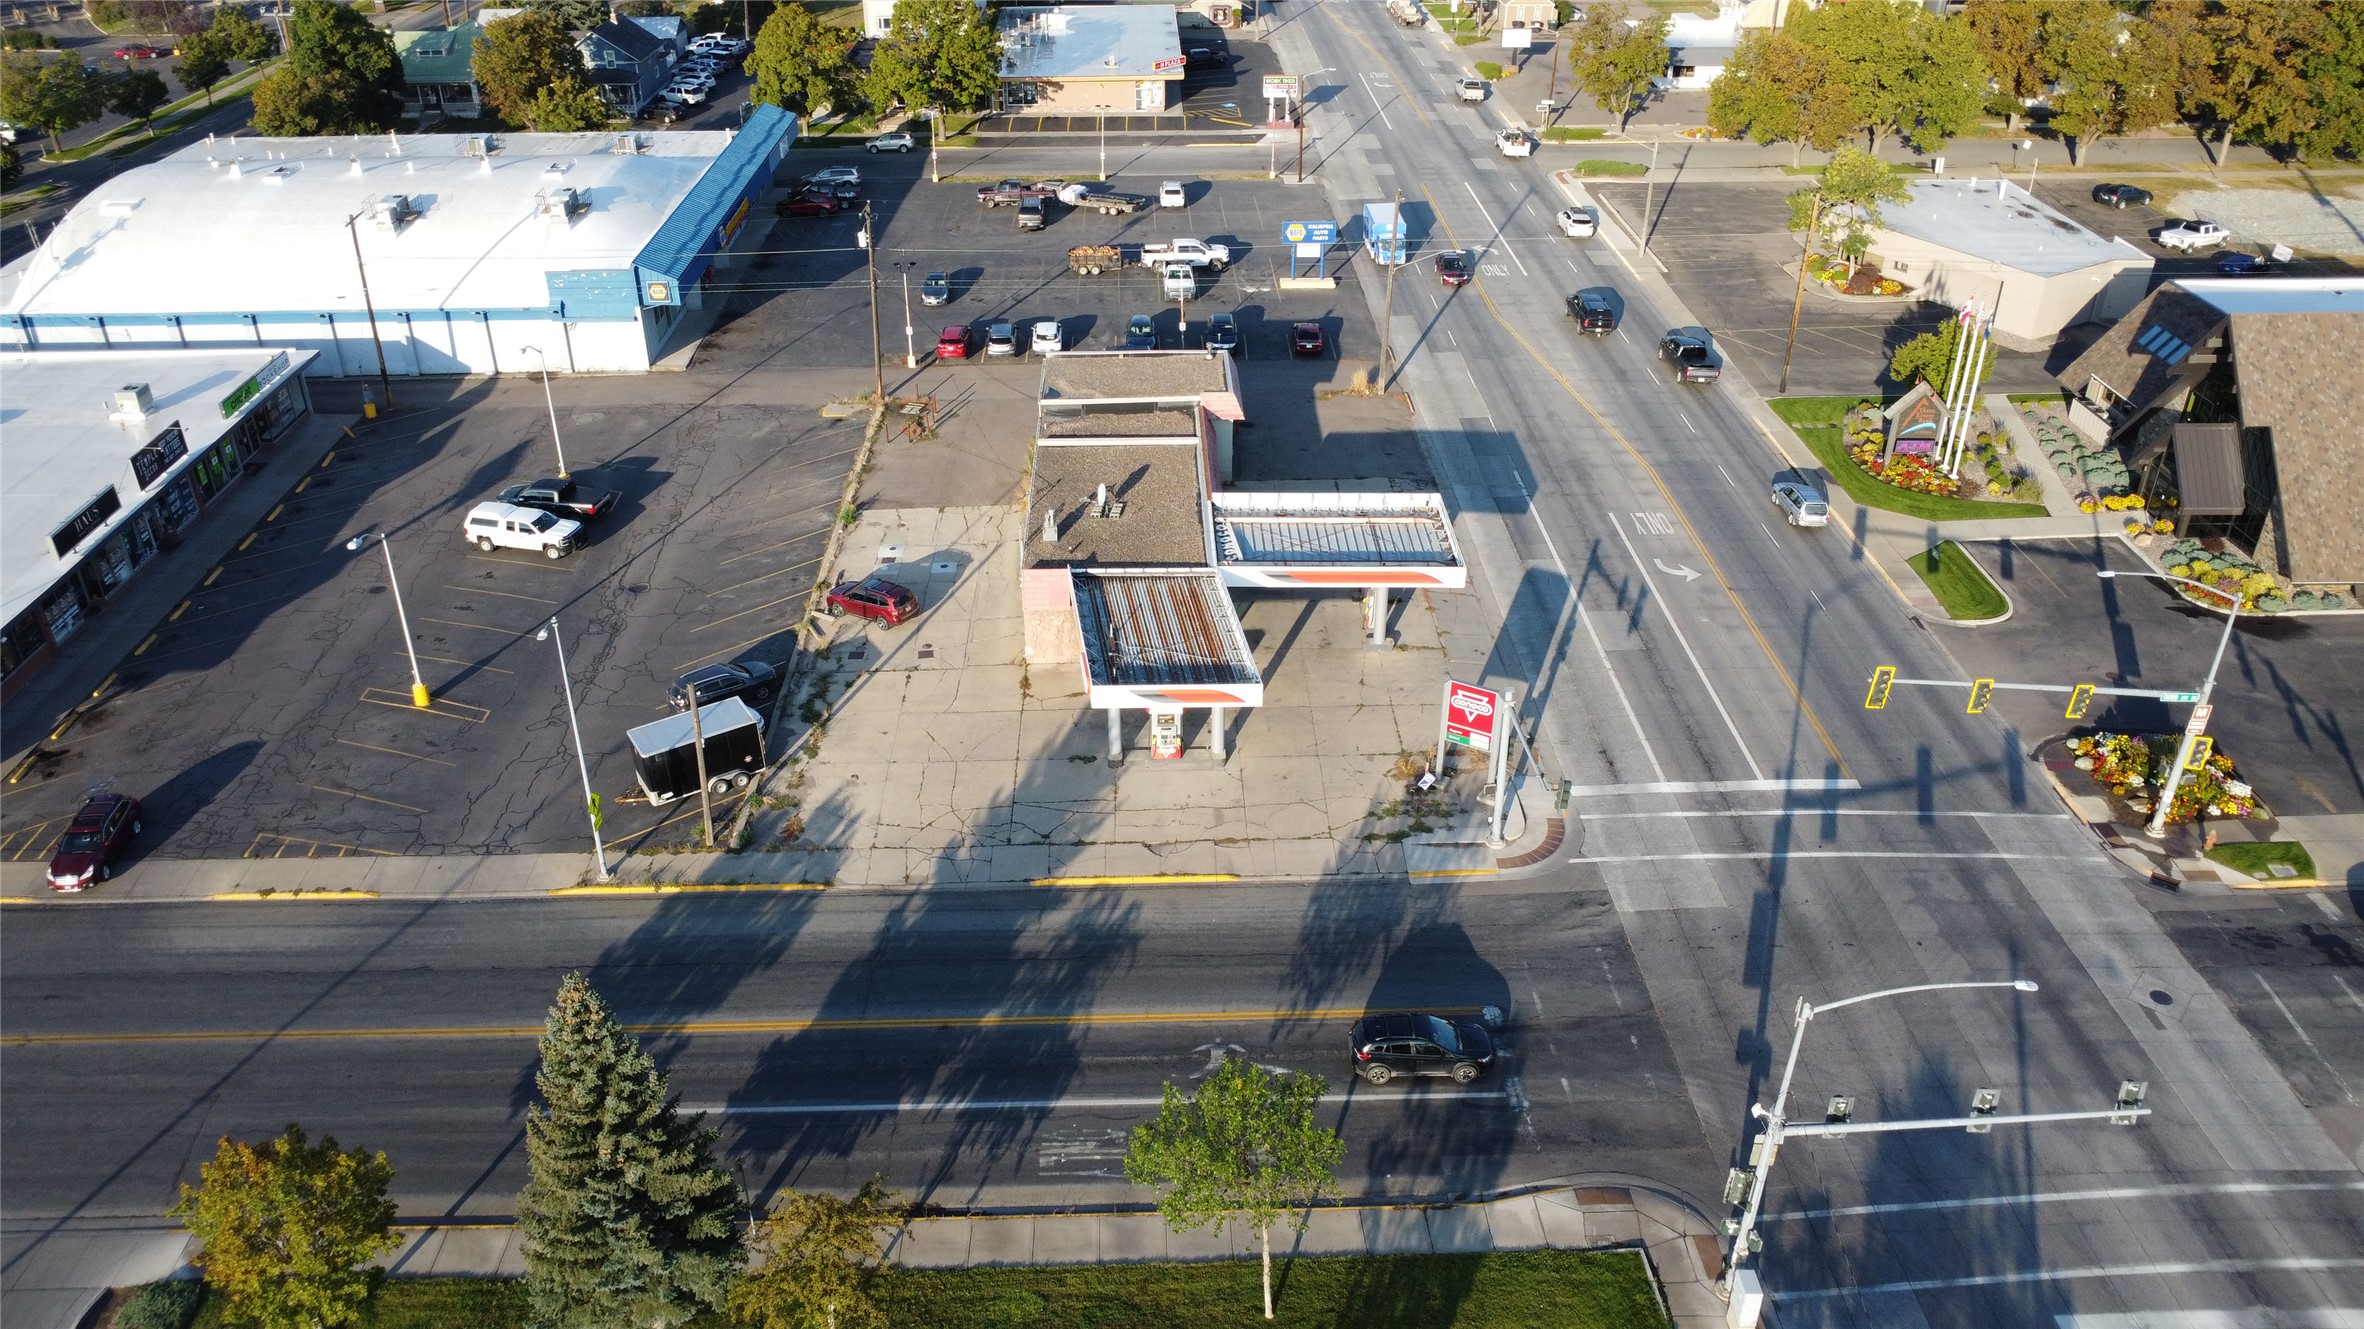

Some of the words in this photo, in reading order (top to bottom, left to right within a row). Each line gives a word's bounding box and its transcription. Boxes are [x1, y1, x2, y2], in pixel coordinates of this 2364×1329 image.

[1481, 264, 1510, 276] ONLY
[136, 449, 159, 476] TEMPLE
[1630, 512, 1675, 535] ONLY
